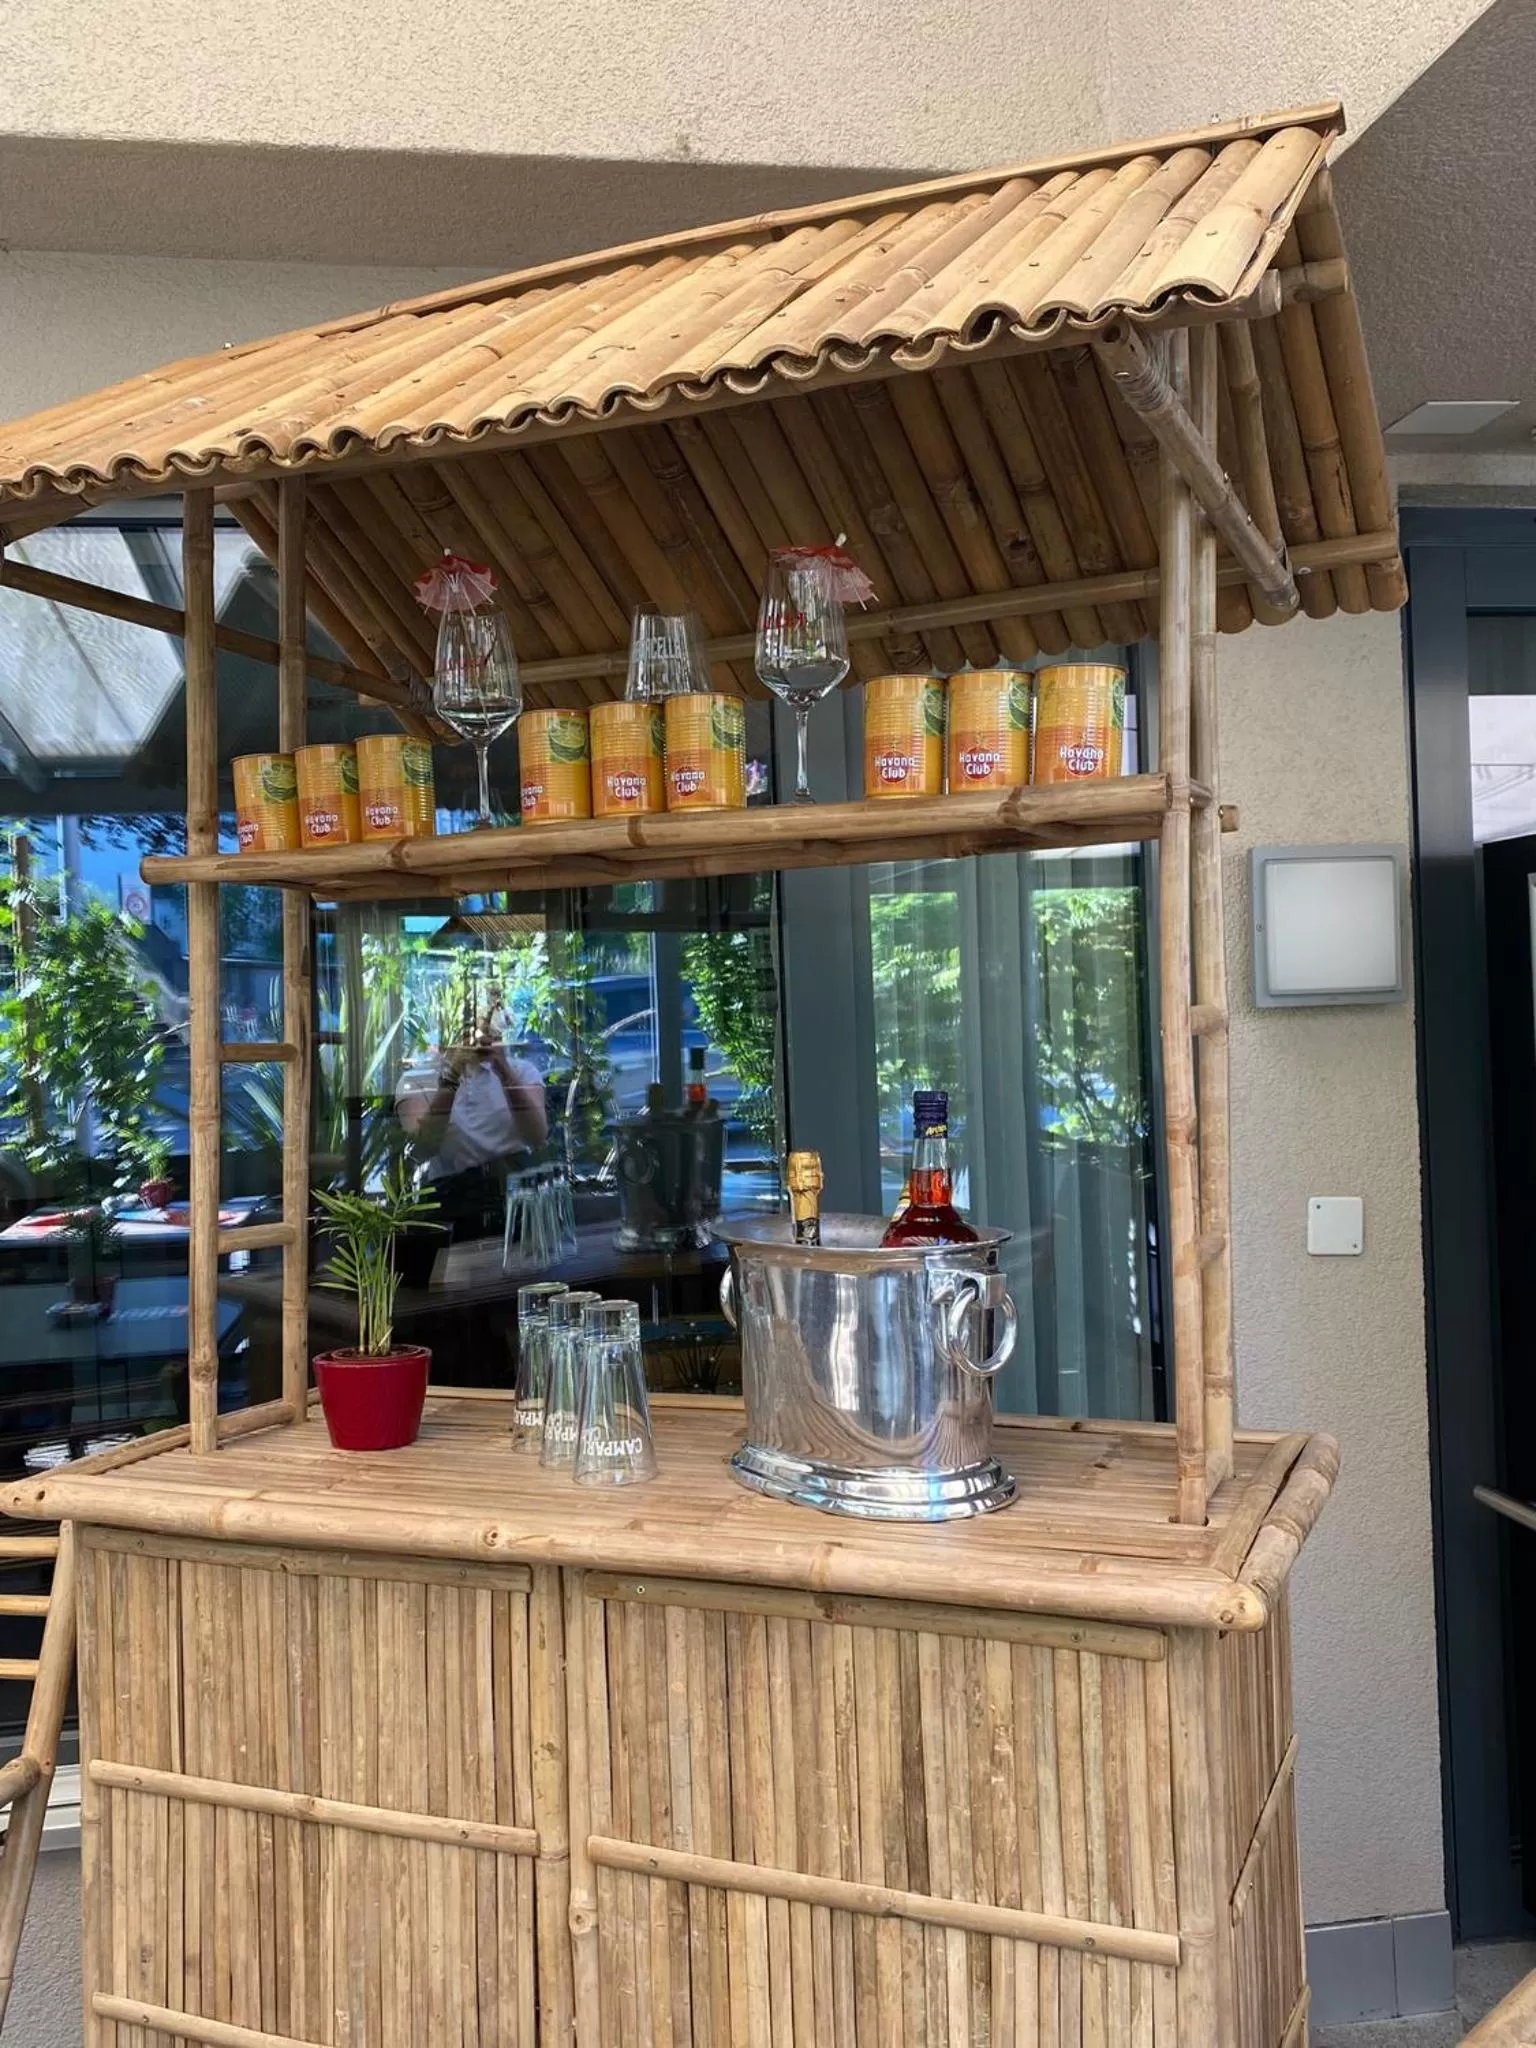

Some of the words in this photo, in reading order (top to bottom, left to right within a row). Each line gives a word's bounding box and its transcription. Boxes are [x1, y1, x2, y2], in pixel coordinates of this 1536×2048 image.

[959, 751, 1001, 764] Havana
[1060, 746, 1104, 760] Havana
[874, 755, 915, 767] Havana
[1068, 758, 1095, 771] Club
[882, 766, 906, 778] Club
[966, 762, 991, 775] Club
[607, 774, 646, 787] Havana
[676, 781, 697, 792] Club
[615, 786, 639, 798] Club
[371, 815, 391, 826] Club
[311, 823, 331, 834] Club
[583, 1437, 643, 1457] CAMPARI
